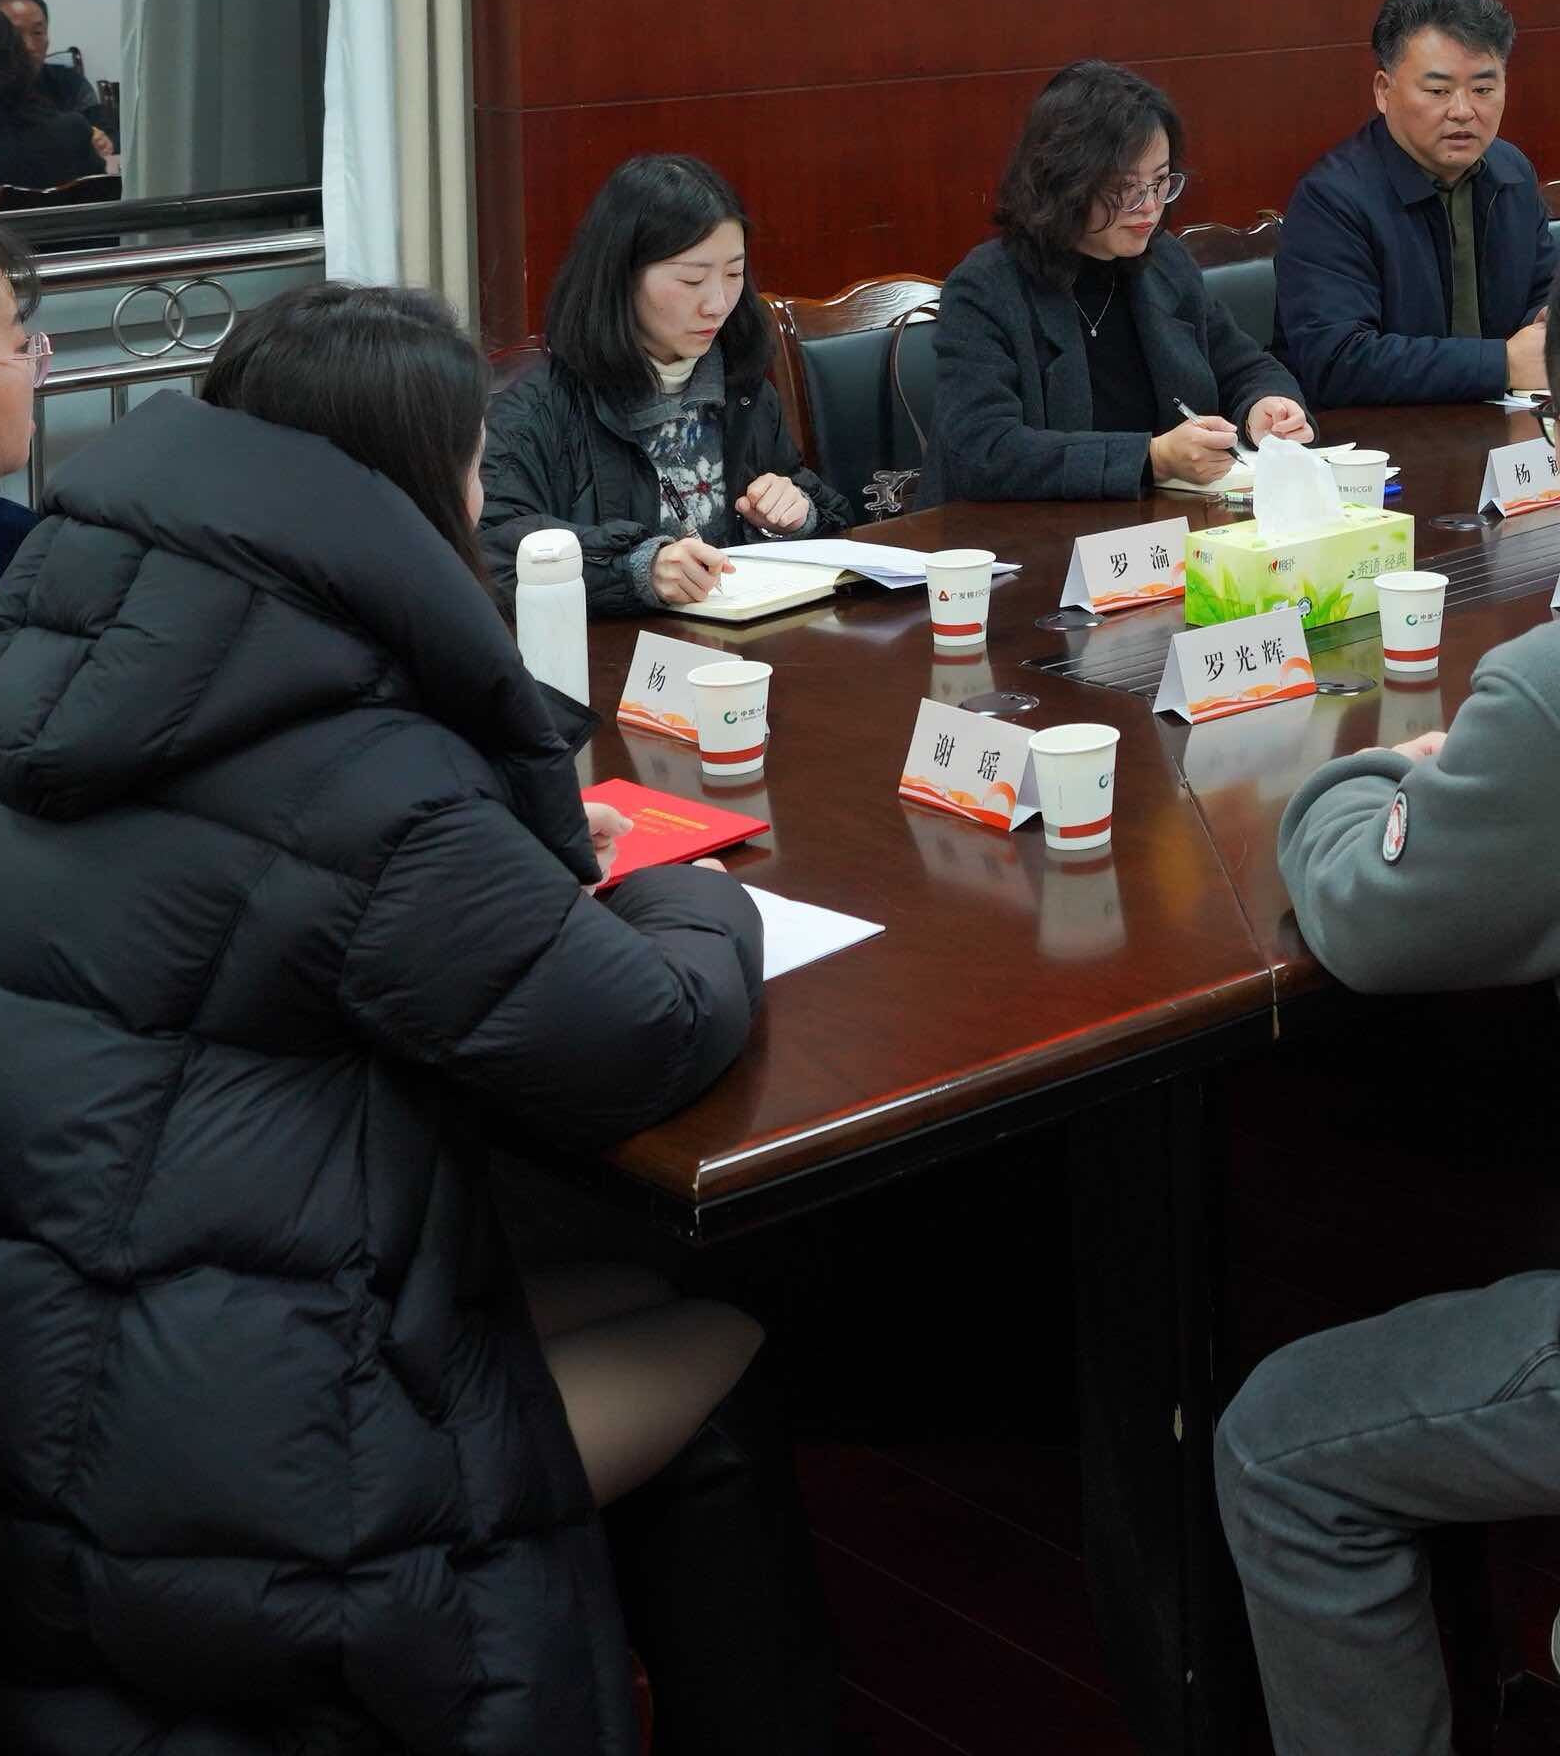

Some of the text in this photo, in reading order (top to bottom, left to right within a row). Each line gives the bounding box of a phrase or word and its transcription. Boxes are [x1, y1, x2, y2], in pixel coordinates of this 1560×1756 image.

[1203, 637, 1286, 683] 罗光辉
[933, 732, 1002, 783] 谢瑶
